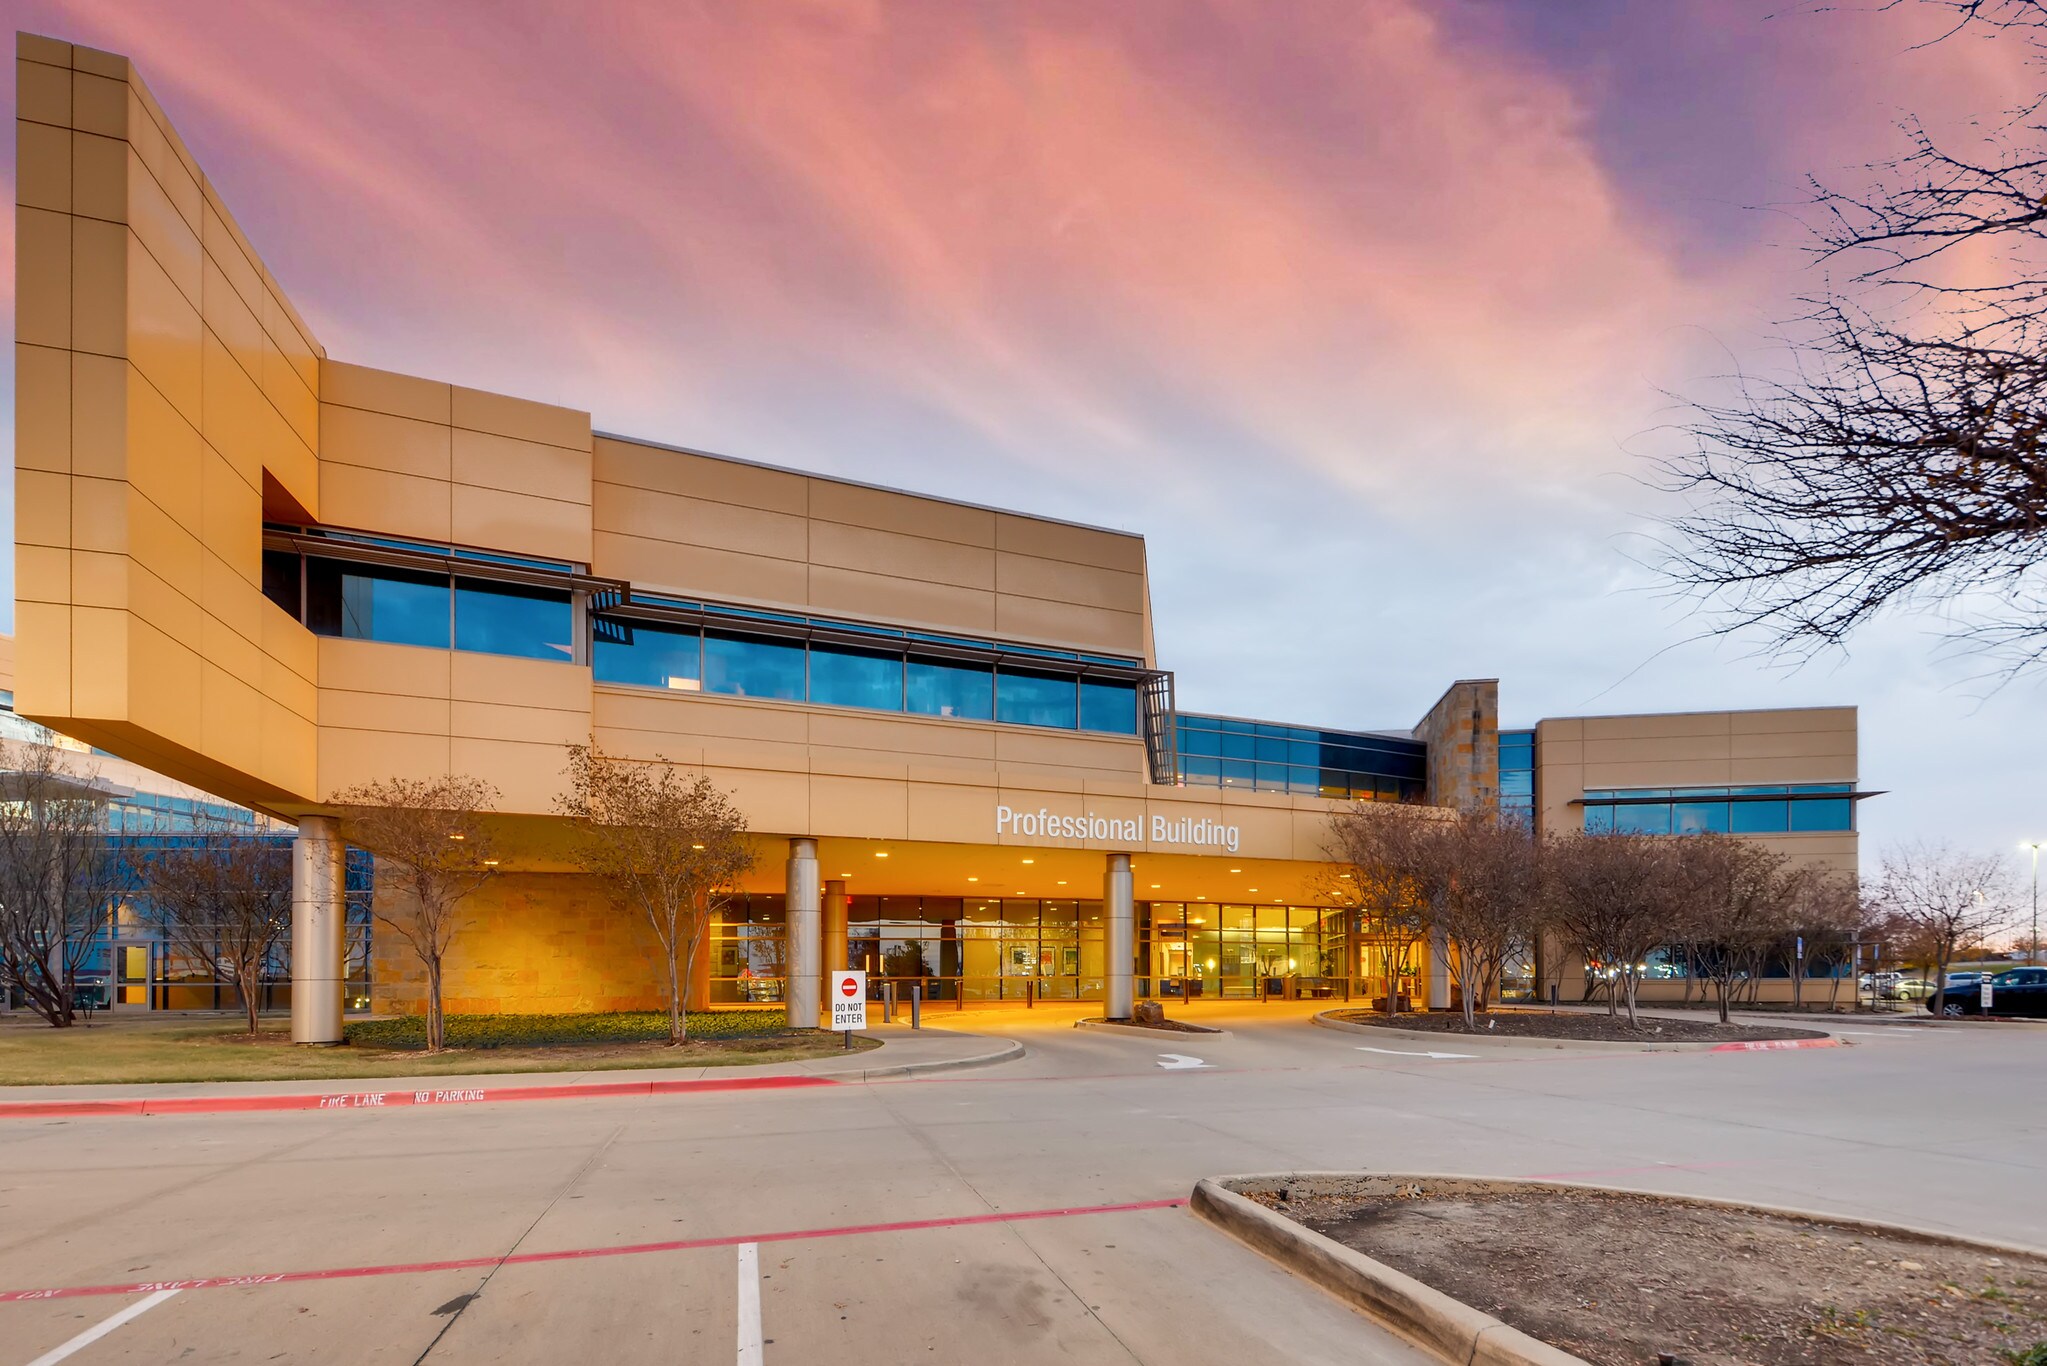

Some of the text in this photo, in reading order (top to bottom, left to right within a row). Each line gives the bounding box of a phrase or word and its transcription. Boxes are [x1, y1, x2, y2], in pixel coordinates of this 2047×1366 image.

[996, 805, 1240, 852] Professional Building
[835, 1002, 863, 1012] DO NOT
[835, 1013, 863, 1024] ENTER
[319, 1093, 386, 1108] FIRE LANE
[414, 1089, 485, 1104] NO PARKING
